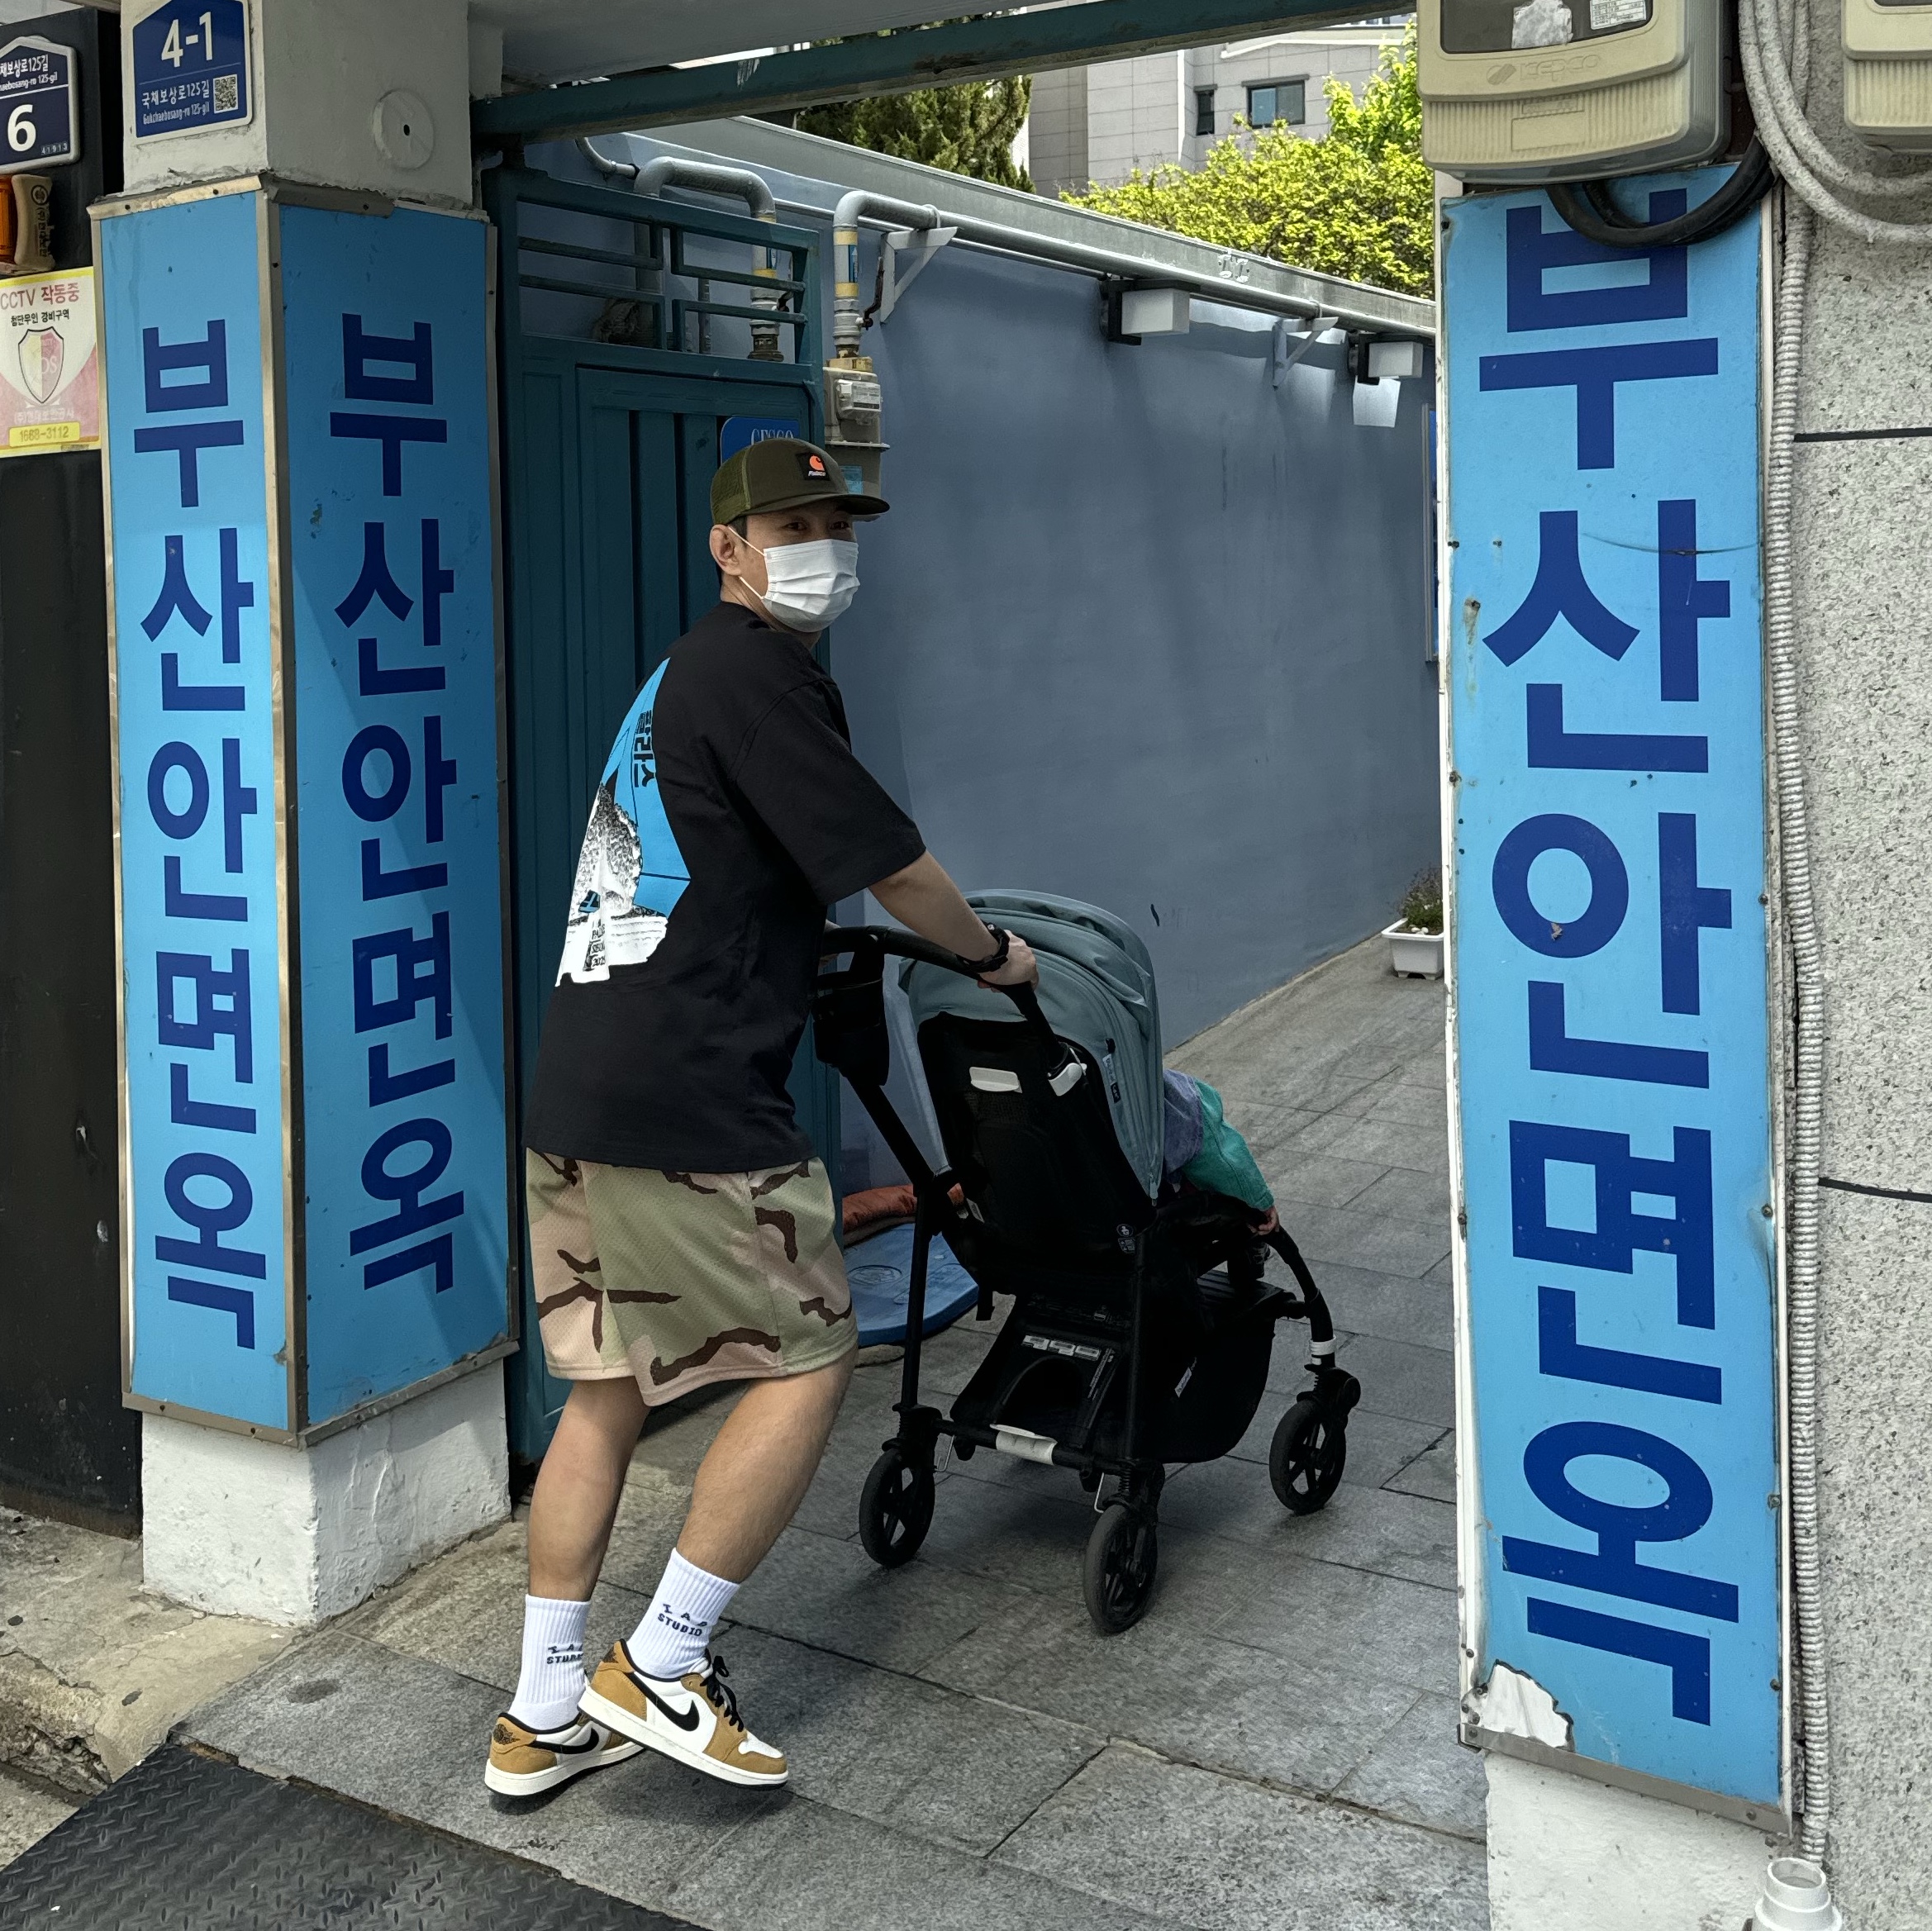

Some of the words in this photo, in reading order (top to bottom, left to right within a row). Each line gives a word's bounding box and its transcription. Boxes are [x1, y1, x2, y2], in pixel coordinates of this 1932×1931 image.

[161, 12, 213, 68] 4-1
[141, 79, 210, 109] 국채보상로125길
[7, 104, 36, 152] 6
[0, 288, 36, 311] CCTV
[40, 282, 80, 305] 작동중
[330, 312, 464, 1295] 부산안면옥
[134, 318, 266, 1350] 부산안면옥
[1479, 188, 1739, 1727] 부산안면옥
[658, 1613, 703, 1637] STUDIO
